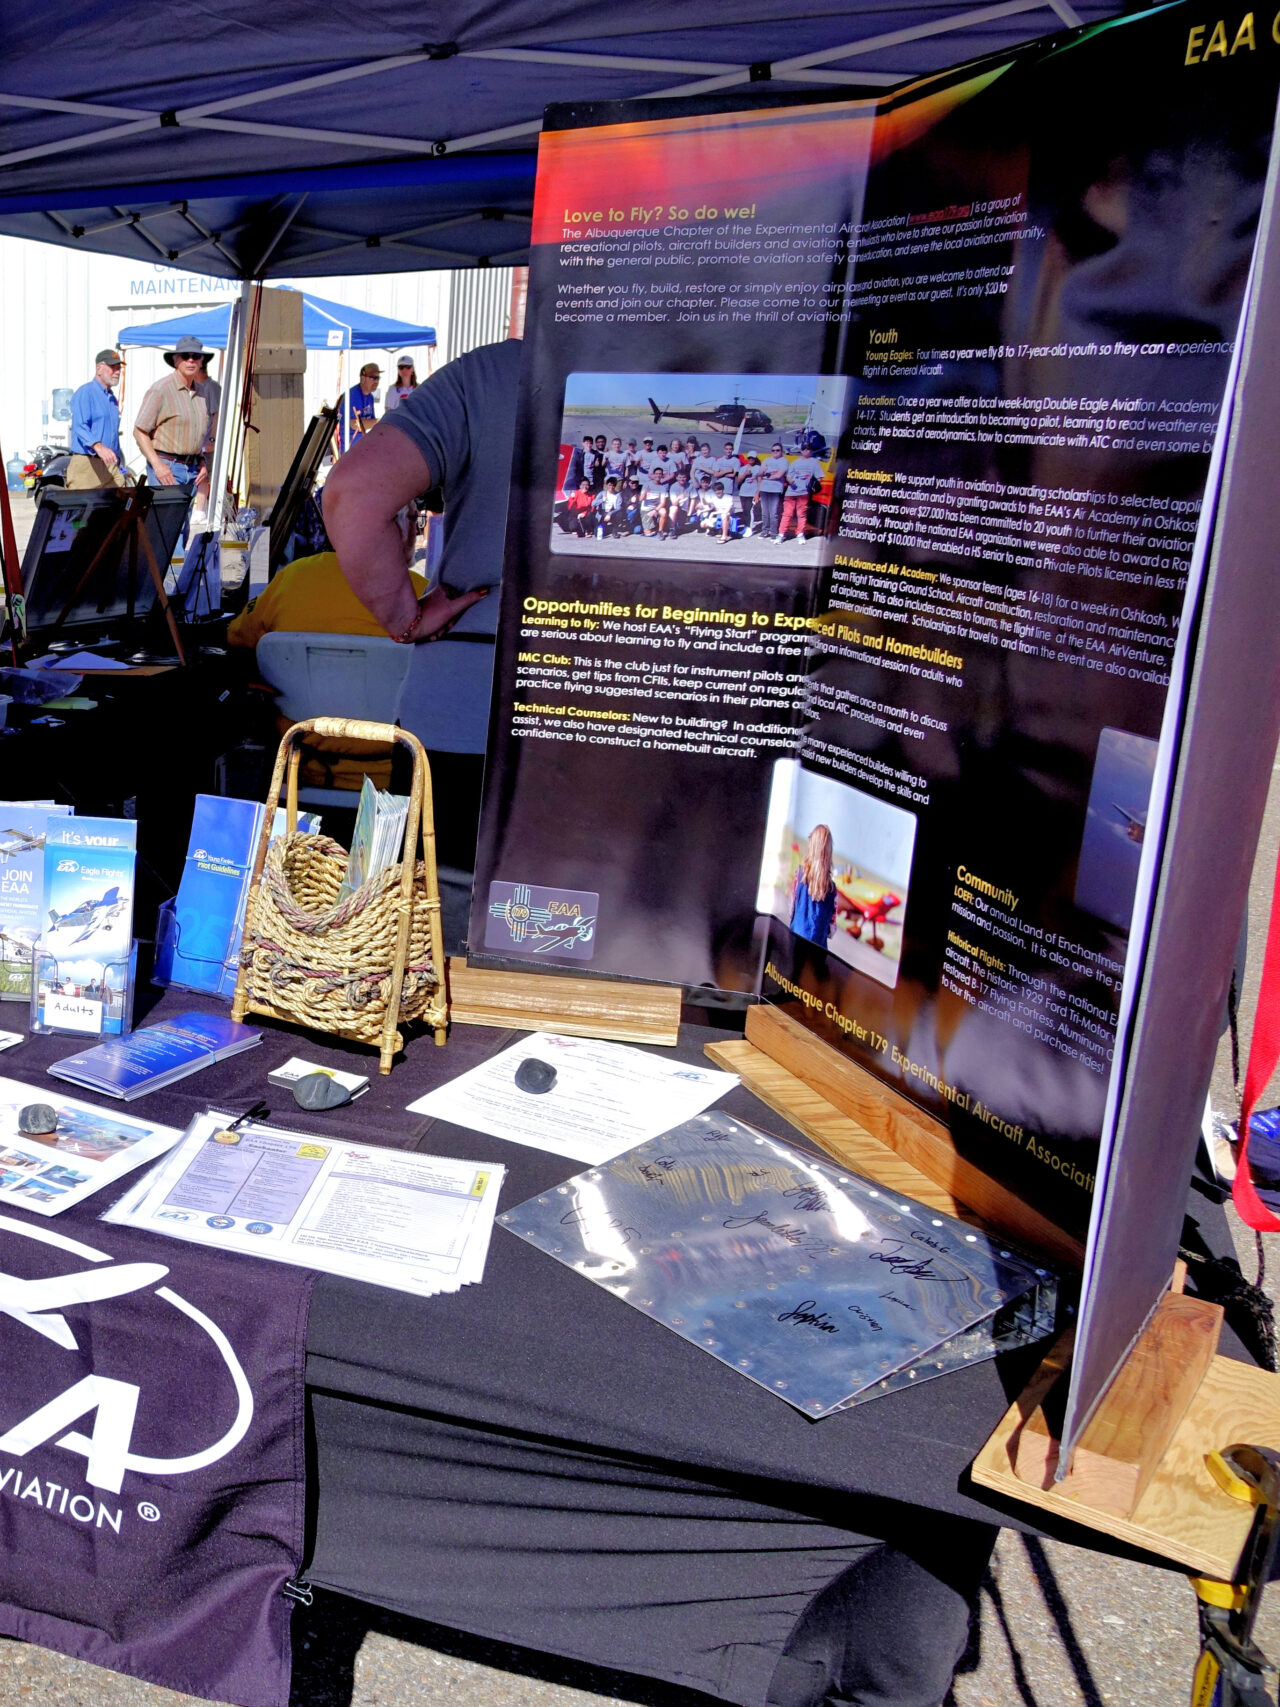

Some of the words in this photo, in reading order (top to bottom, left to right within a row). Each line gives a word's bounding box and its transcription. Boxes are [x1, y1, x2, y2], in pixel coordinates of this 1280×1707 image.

[1184, 12, 1256, 65] EAA
[564, 209, 603, 223] Love
[609, 209, 624, 221] to
[630, 207, 663, 224] Fly?
[668, 207, 689, 220] So
[695, 206, 717, 219] do
[724, 205, 756, 218] we!
[870, 329, 898, 344] Youth
[866, 351, 888, 362] Young
[889, 350, 913, 362] Eagles:
[858, 396, 896, 406] Education:
[847, 469, 893, 484] Scholarships:
[835, 555, 847, 566] EAA
[849, 558, 886, 573] Advanced
[887, 564, 899, 575] Air
[901, 566, 938, 582] Academy:
[522, 616, 568, 630] Learning
[571, 619, 581, 627] to
[584, 620, 599, 632] fly:
[603, 622, 620, 630] We
[624, 623, 646, 633] host
[649, 625, 680, 635] EAA's
[524, 598, 631, 617] Opportunities
[635, 604, 657, 618] for
[662, 606, 746, 627] Beginning
[752, 612, 769, 626] to
[838, 624, 860, 644] Pilots
[862, 630, 883, 649] and
[885, 632, 962, 670] Homebuilders
[519, 653, 540, 663] IMC
[543, 655, 571, 665] Club:
[574, 657, 591, 667] This
[594, 658, 602, 668] is
[604, 659, 622, 669] the
[625, 661, 650, 671] club
[652, 663, 670, 674] just
[674, 664, 688, 674] for
[691, 665, 750, 679] instrument
[753, 670, 783, 682] pilots
[514, 703, 565, 715] Technical
[568, 707, 630, 720] Counselors:
[633, 713, 658, 723] New
[661, 715, 672, 724] to
[676, 716, 727, 730] building?
[733, 721, 744, 730] In
[62, 830, 80, 844] It's
[85, 836, 119, 846] your
[1, 869, 32, 882] JOIN
[56, 864, 76, 872] EAA
[80, 866, 100, 876] Eagle
[211, 864, 241, 875] Guidelines
[1, 881, 30, 894] EAA
[957, 865, 1019, 911] Community
[513, 908, 528, 917] 179
[548, 902, 581, 916] EAA
[948, 930, 979, 961] Historical
[980, 948, 1006, 973] Flights:
[54, 1002, 94, 1016] Adults
[765, 962, 823, 1012] Albuquerque
[825, 1001, 867, 1041] Chapter
[870, 1031, 888, 1055] 179
[890, 1046, 970, 1110] Experimental
[973, 1095, 1025, 1145] Aircraft
[158, 1211, 190, 1221] EAA
